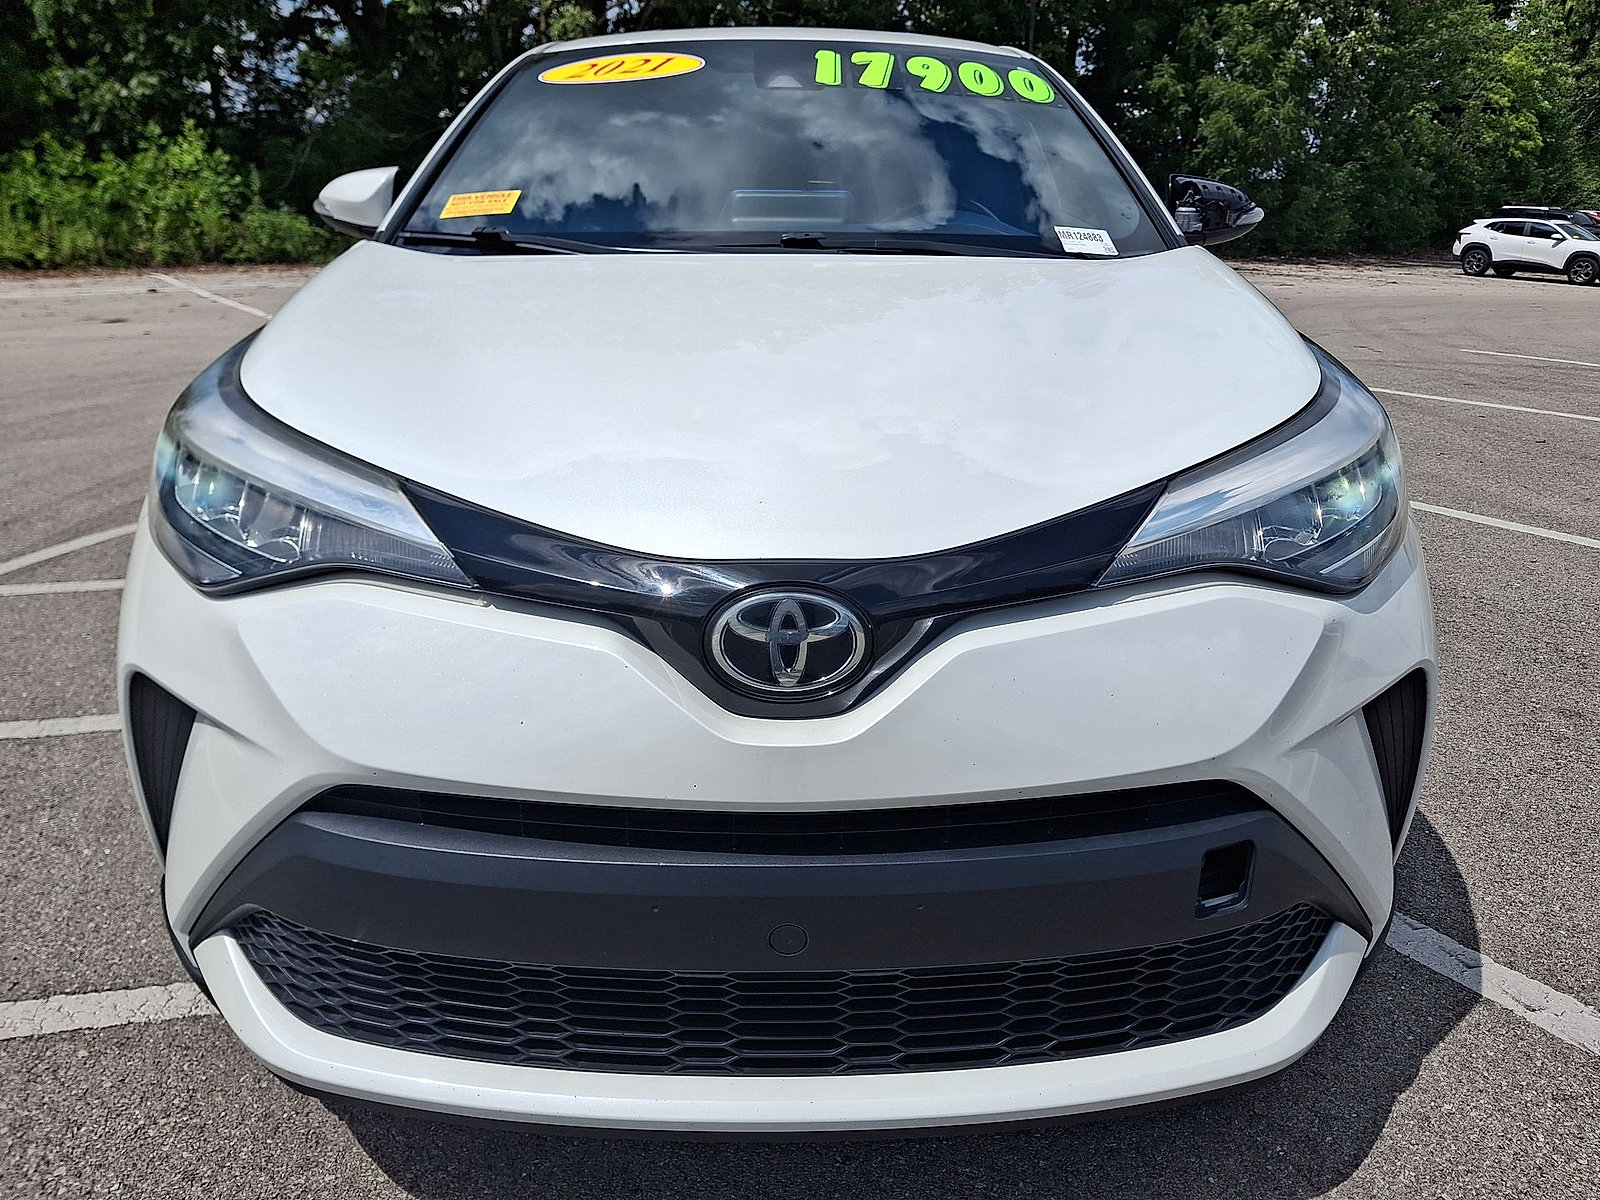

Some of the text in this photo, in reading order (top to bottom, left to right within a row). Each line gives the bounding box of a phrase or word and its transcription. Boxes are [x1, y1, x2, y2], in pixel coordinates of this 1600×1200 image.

[566, 57, 676, 80] 2021
[815, 50, 1055, 104] 17900
[475, 192, 513, 200] VEHICLE
